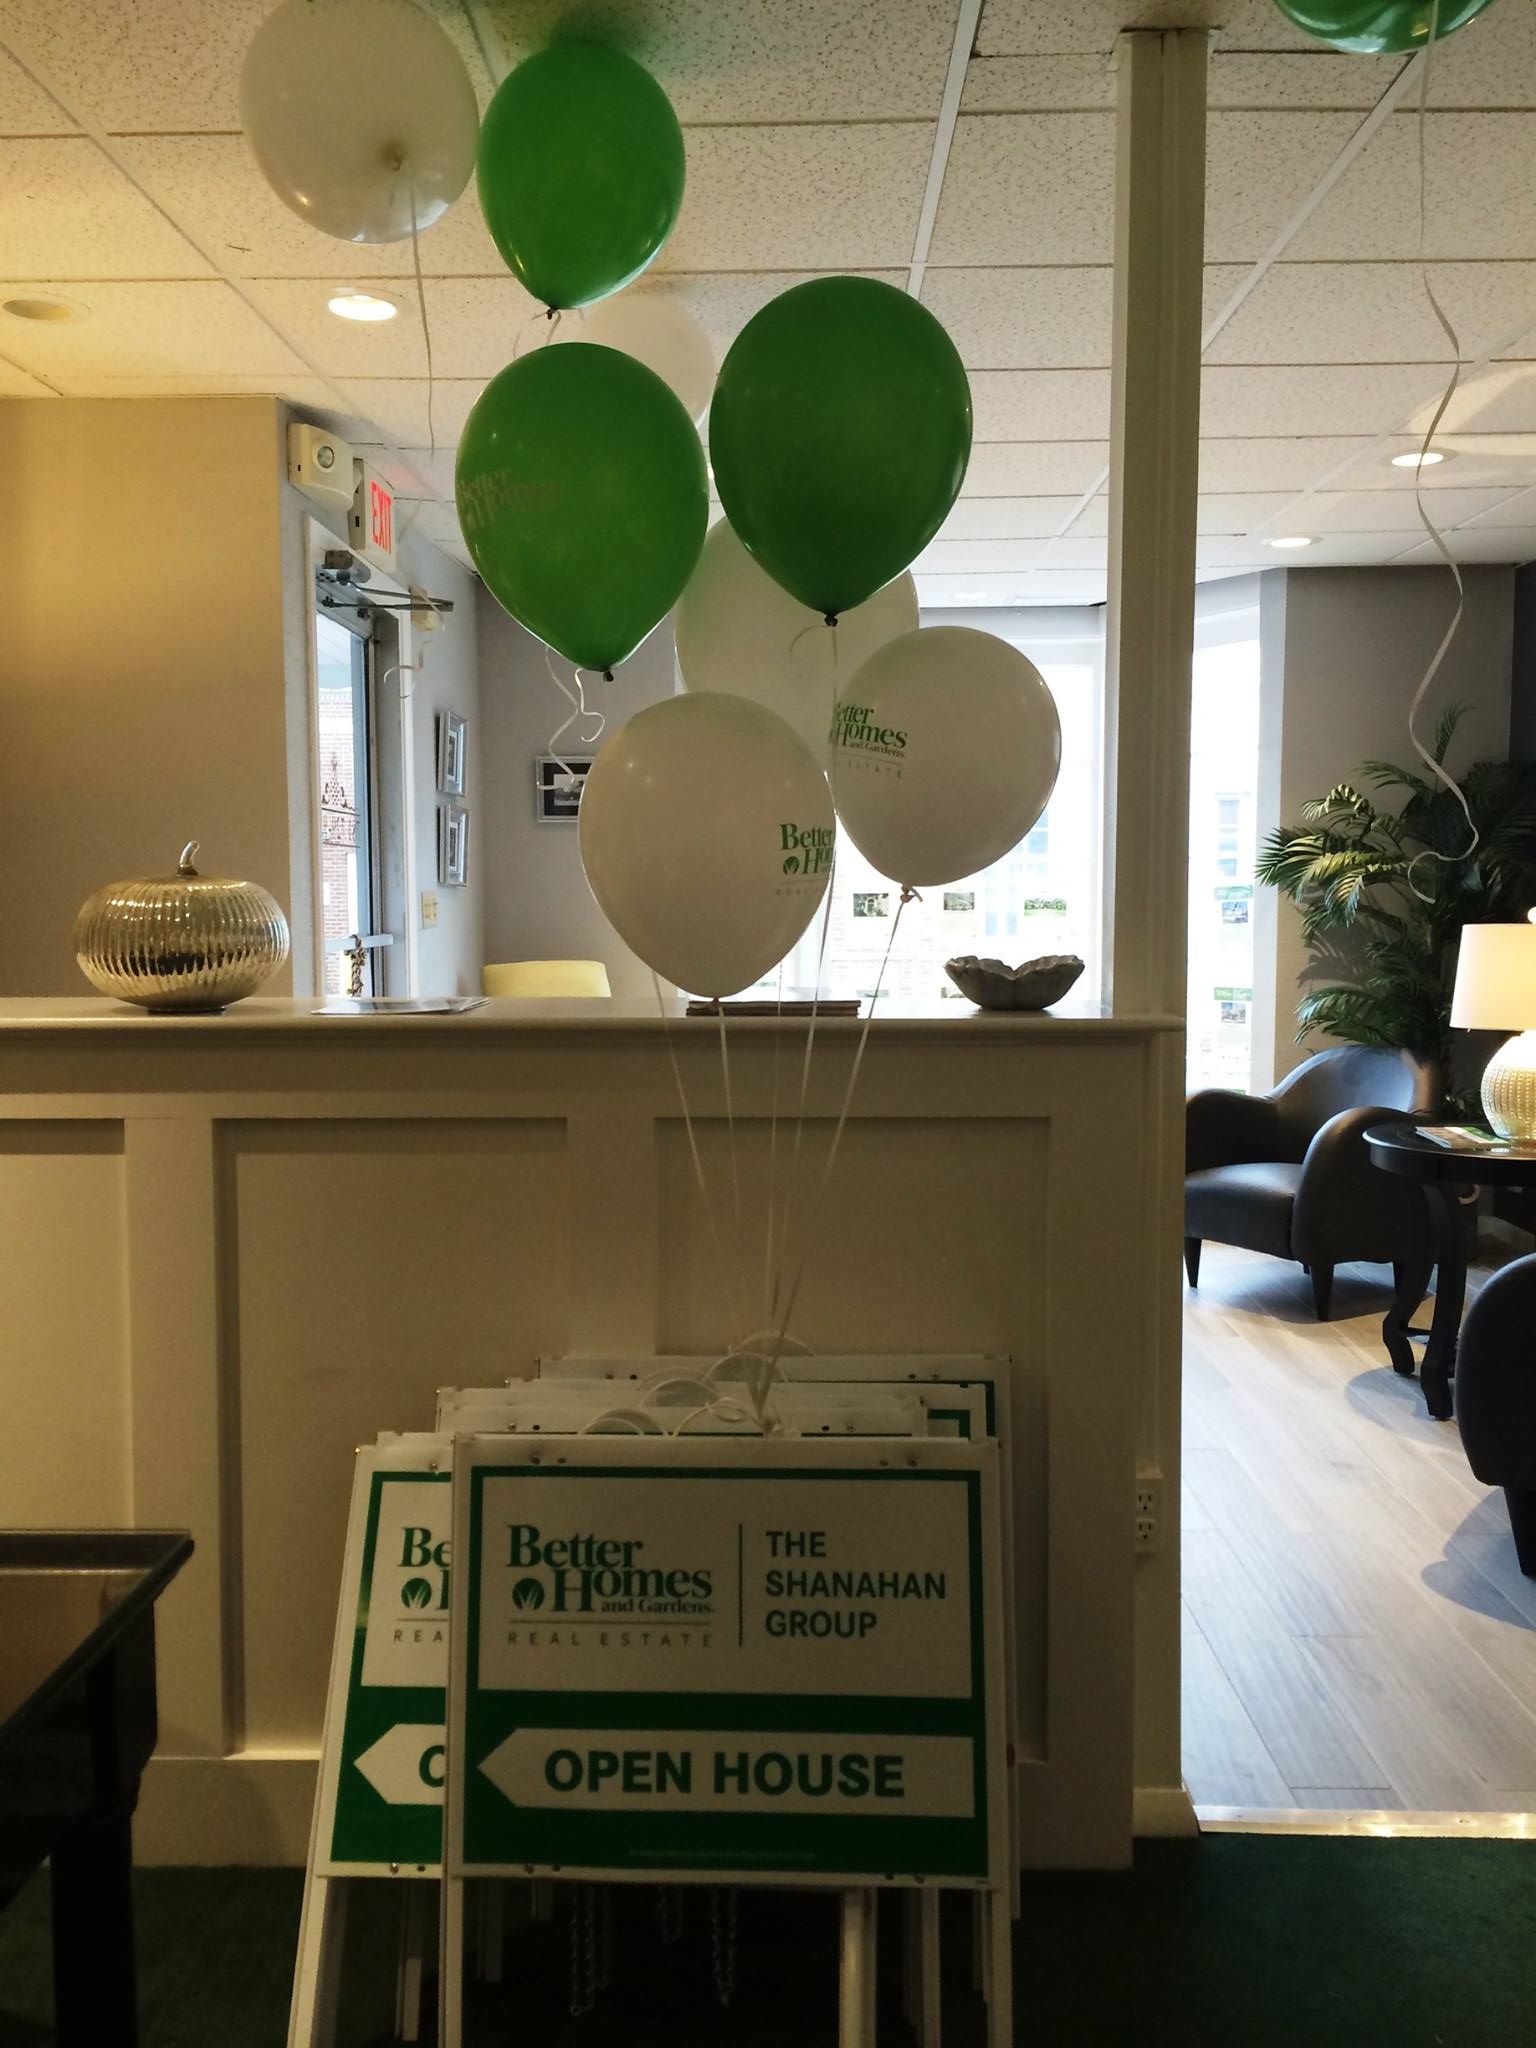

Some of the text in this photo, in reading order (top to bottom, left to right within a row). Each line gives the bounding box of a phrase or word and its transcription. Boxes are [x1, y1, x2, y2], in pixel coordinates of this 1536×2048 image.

[370, 480, 391, 554] EXIT
[835, 722, 909, 750] Homes
[780, 823, 834, 850] Better
[507, 1524, 643, 1567] Better
[765, 1531, 827, 1558] THE
[550, 1567, 713, 1613] Homes
[765, 1571, 946, 1600] SHANAHAN
[601, 1599, 713, 1615] and Gardens
[765, 1611, 878, 1639] GROUP
[507, 1631, 713, 1648] REAL ESTATE
[543, 1748, 906, 1798] OPEN HOUSE
